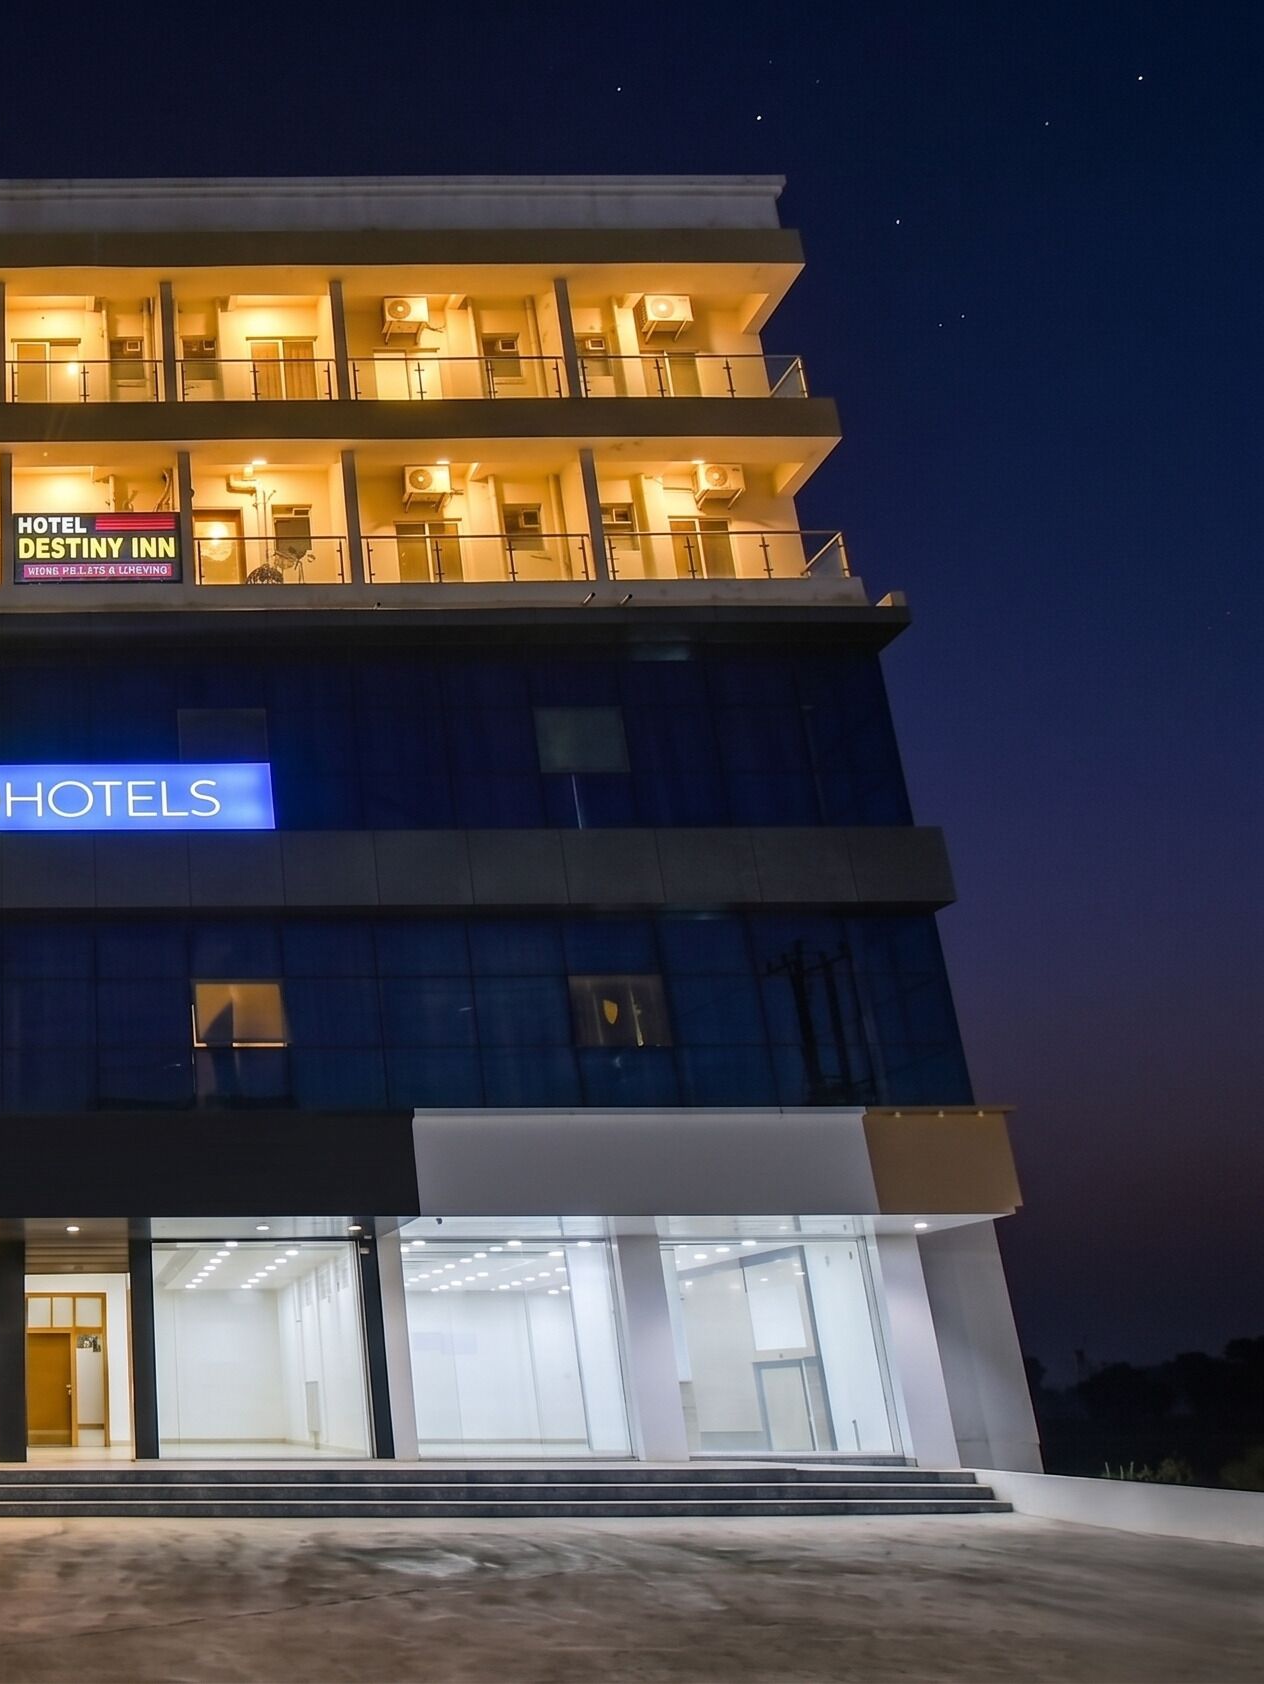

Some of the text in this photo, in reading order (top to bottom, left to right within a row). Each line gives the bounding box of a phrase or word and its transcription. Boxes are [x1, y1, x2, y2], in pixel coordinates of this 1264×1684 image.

[18, 516, 87, 534] HOTEL
[18, 537, 176, 559] DESTINY INN
